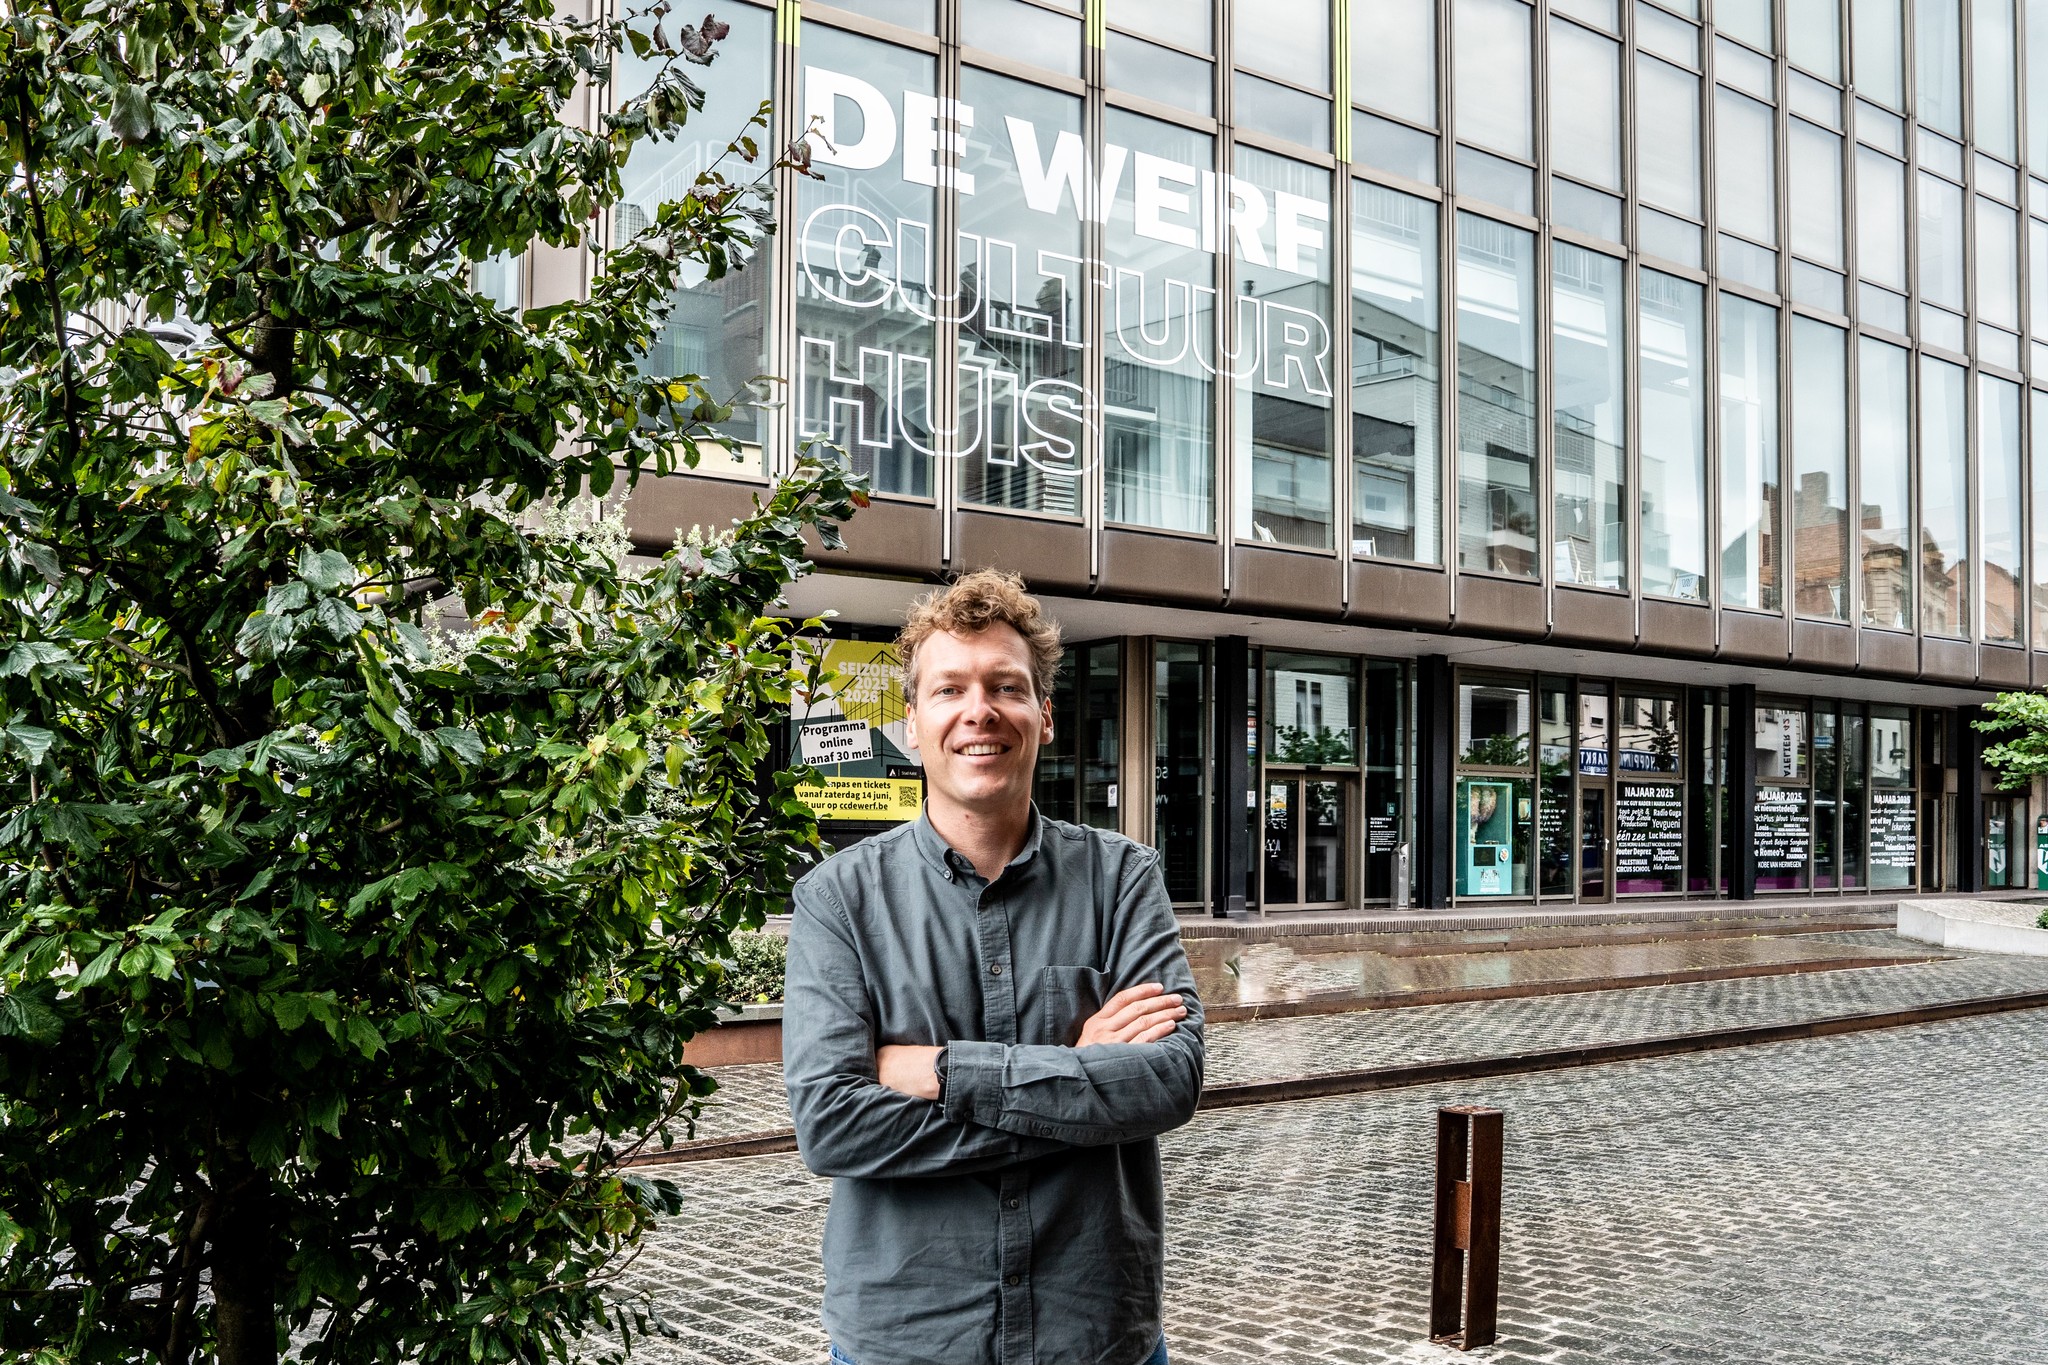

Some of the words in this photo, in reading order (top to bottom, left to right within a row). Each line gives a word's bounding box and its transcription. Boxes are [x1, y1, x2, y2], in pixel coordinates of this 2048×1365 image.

[804, 65, 975, 196] DE
[1004, 115, 1330, 278] WERF
[801, 204, 1334, 398] CULTUUR
[799, 336, 1101, 476] HUIS
[855, 677, 889, 691] 2025
[843, 689, 879, 704] 2026
[803, 722, 866, 737] Programma
[820, 736, 853, 749] online
[804, 751, 835, 765] vanaf
[836, 751, 849, 762] 30
[852, 747, 872, 760] mei
[852, 781, 862, 789] en
[864, 780, 891, 789] tickets
[799, 790, 823, 798] vanaf
[824, 791, 860, 800] zaterdag
[862, 791, 872, 799] 14
[872, 791, 892, 801] juni,
[1624, 786, 1655, 798] NAJAAR
[1656, 787, 1675, 798] 2025
[1758, 790, 1786, 801] NAJAAR
[1786, 791, 1802, 801] 2025
[1873, 794, 1896, 805] NAJAAR
[827, 803, 838, 811] op
[840, 801, 888, 811] ccdewerf.be
[1652, 818, 1681, 831] Yevgueni
[1756, 823, 1770, 831] Louis
[1616, 830, 1631, 841] één
[1631, 832, 1646, 841] zee
[1648, 831, 1659, 840] Luc
[1760, 847, 1785, 857] Romeo's
